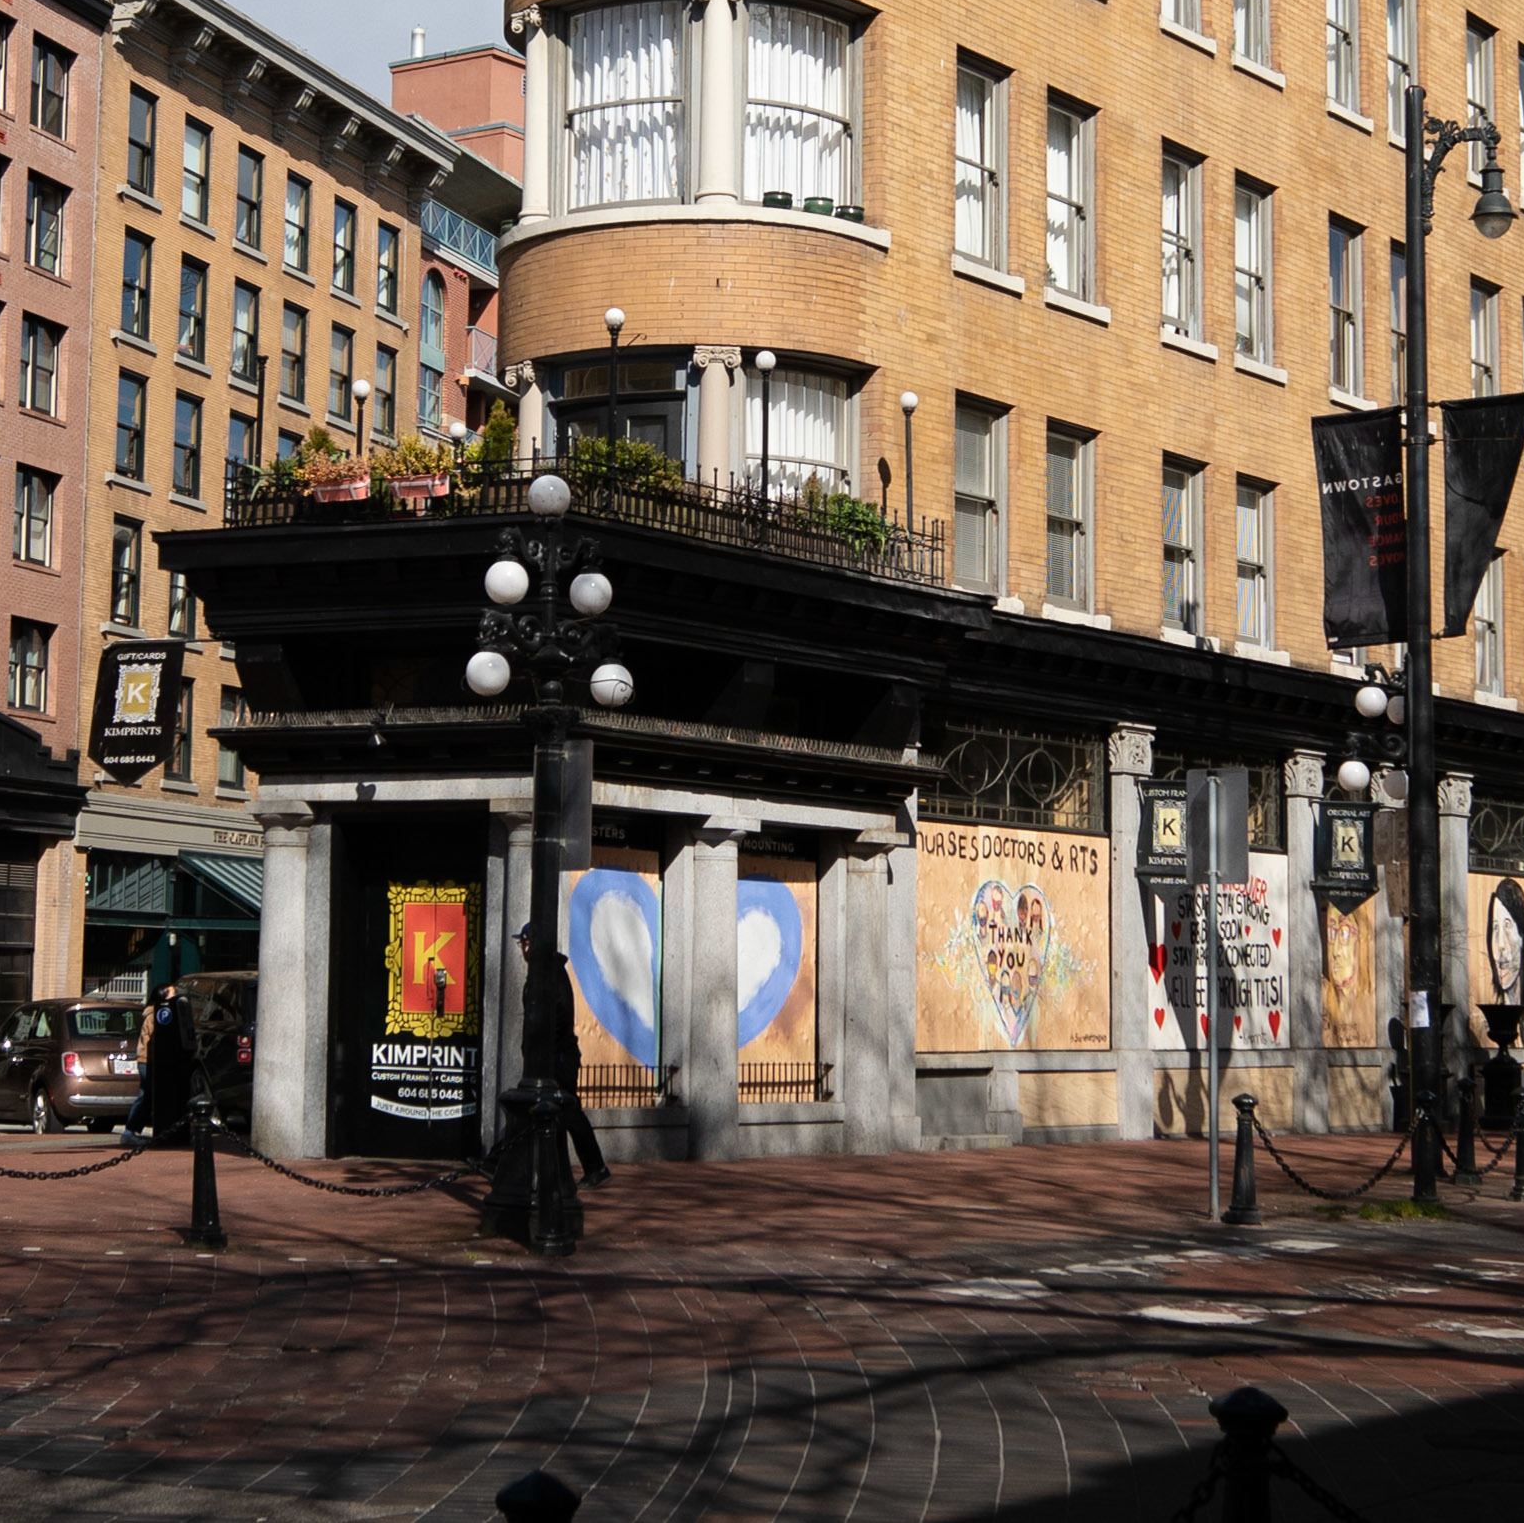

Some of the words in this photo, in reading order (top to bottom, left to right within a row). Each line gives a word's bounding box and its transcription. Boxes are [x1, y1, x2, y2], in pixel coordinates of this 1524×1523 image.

[126, 682, 148, 704] K
[104, 726, 162, 737] KIMPRINTS
[213, 830, 228, 843] THE
[1162, 818, 1176, 836] K
[1341, 836, 1355, 852] K
[982, 834, 1047, 867] DOCTORS
[1051, 841, 1065, 871] &
[1069, 844, 1098, 876] RTS
[1236, 893, 1270, 926] STRONG
[988, 924, 1033, 946] THANK
[412, 931, 457, 985] K
[998, 949, 1025, 970] YOU
[1254, 975, 1283, 1013] THIS!
[397, 1087, 417, 1098] 604
